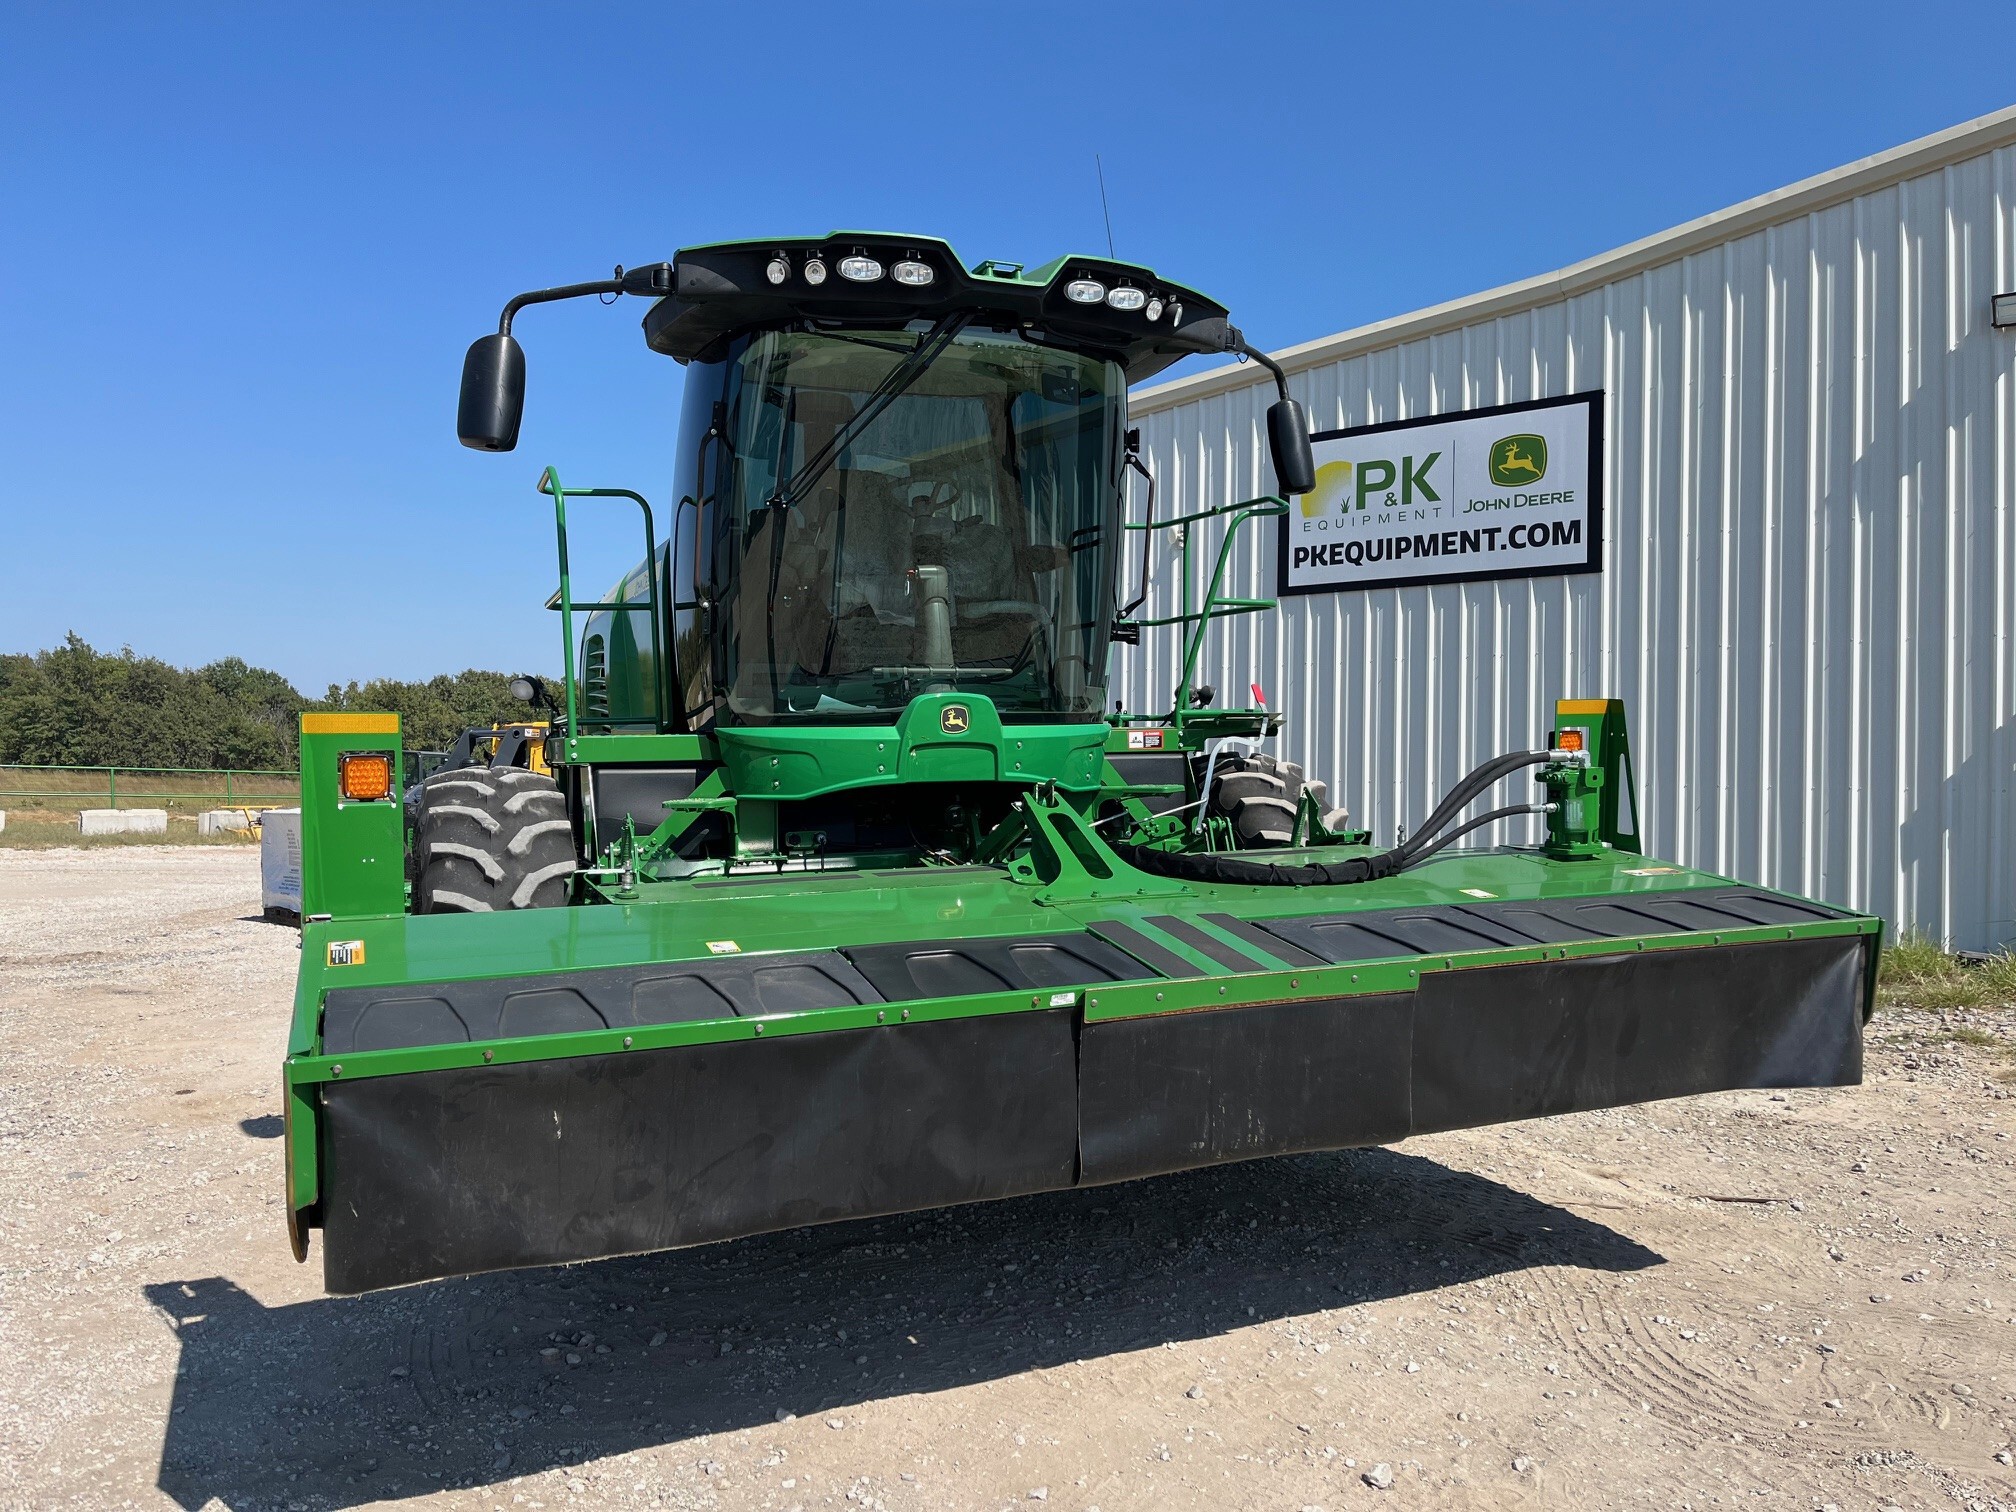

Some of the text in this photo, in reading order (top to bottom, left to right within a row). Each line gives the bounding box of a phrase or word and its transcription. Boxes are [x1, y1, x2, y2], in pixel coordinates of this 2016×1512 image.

[1356, 452, 1442, 510] P&K
[1294, 519, 1581, 569] PKEQUIPMENT.COM
[1303, 507, 1442, 532] EQUIPMENT
